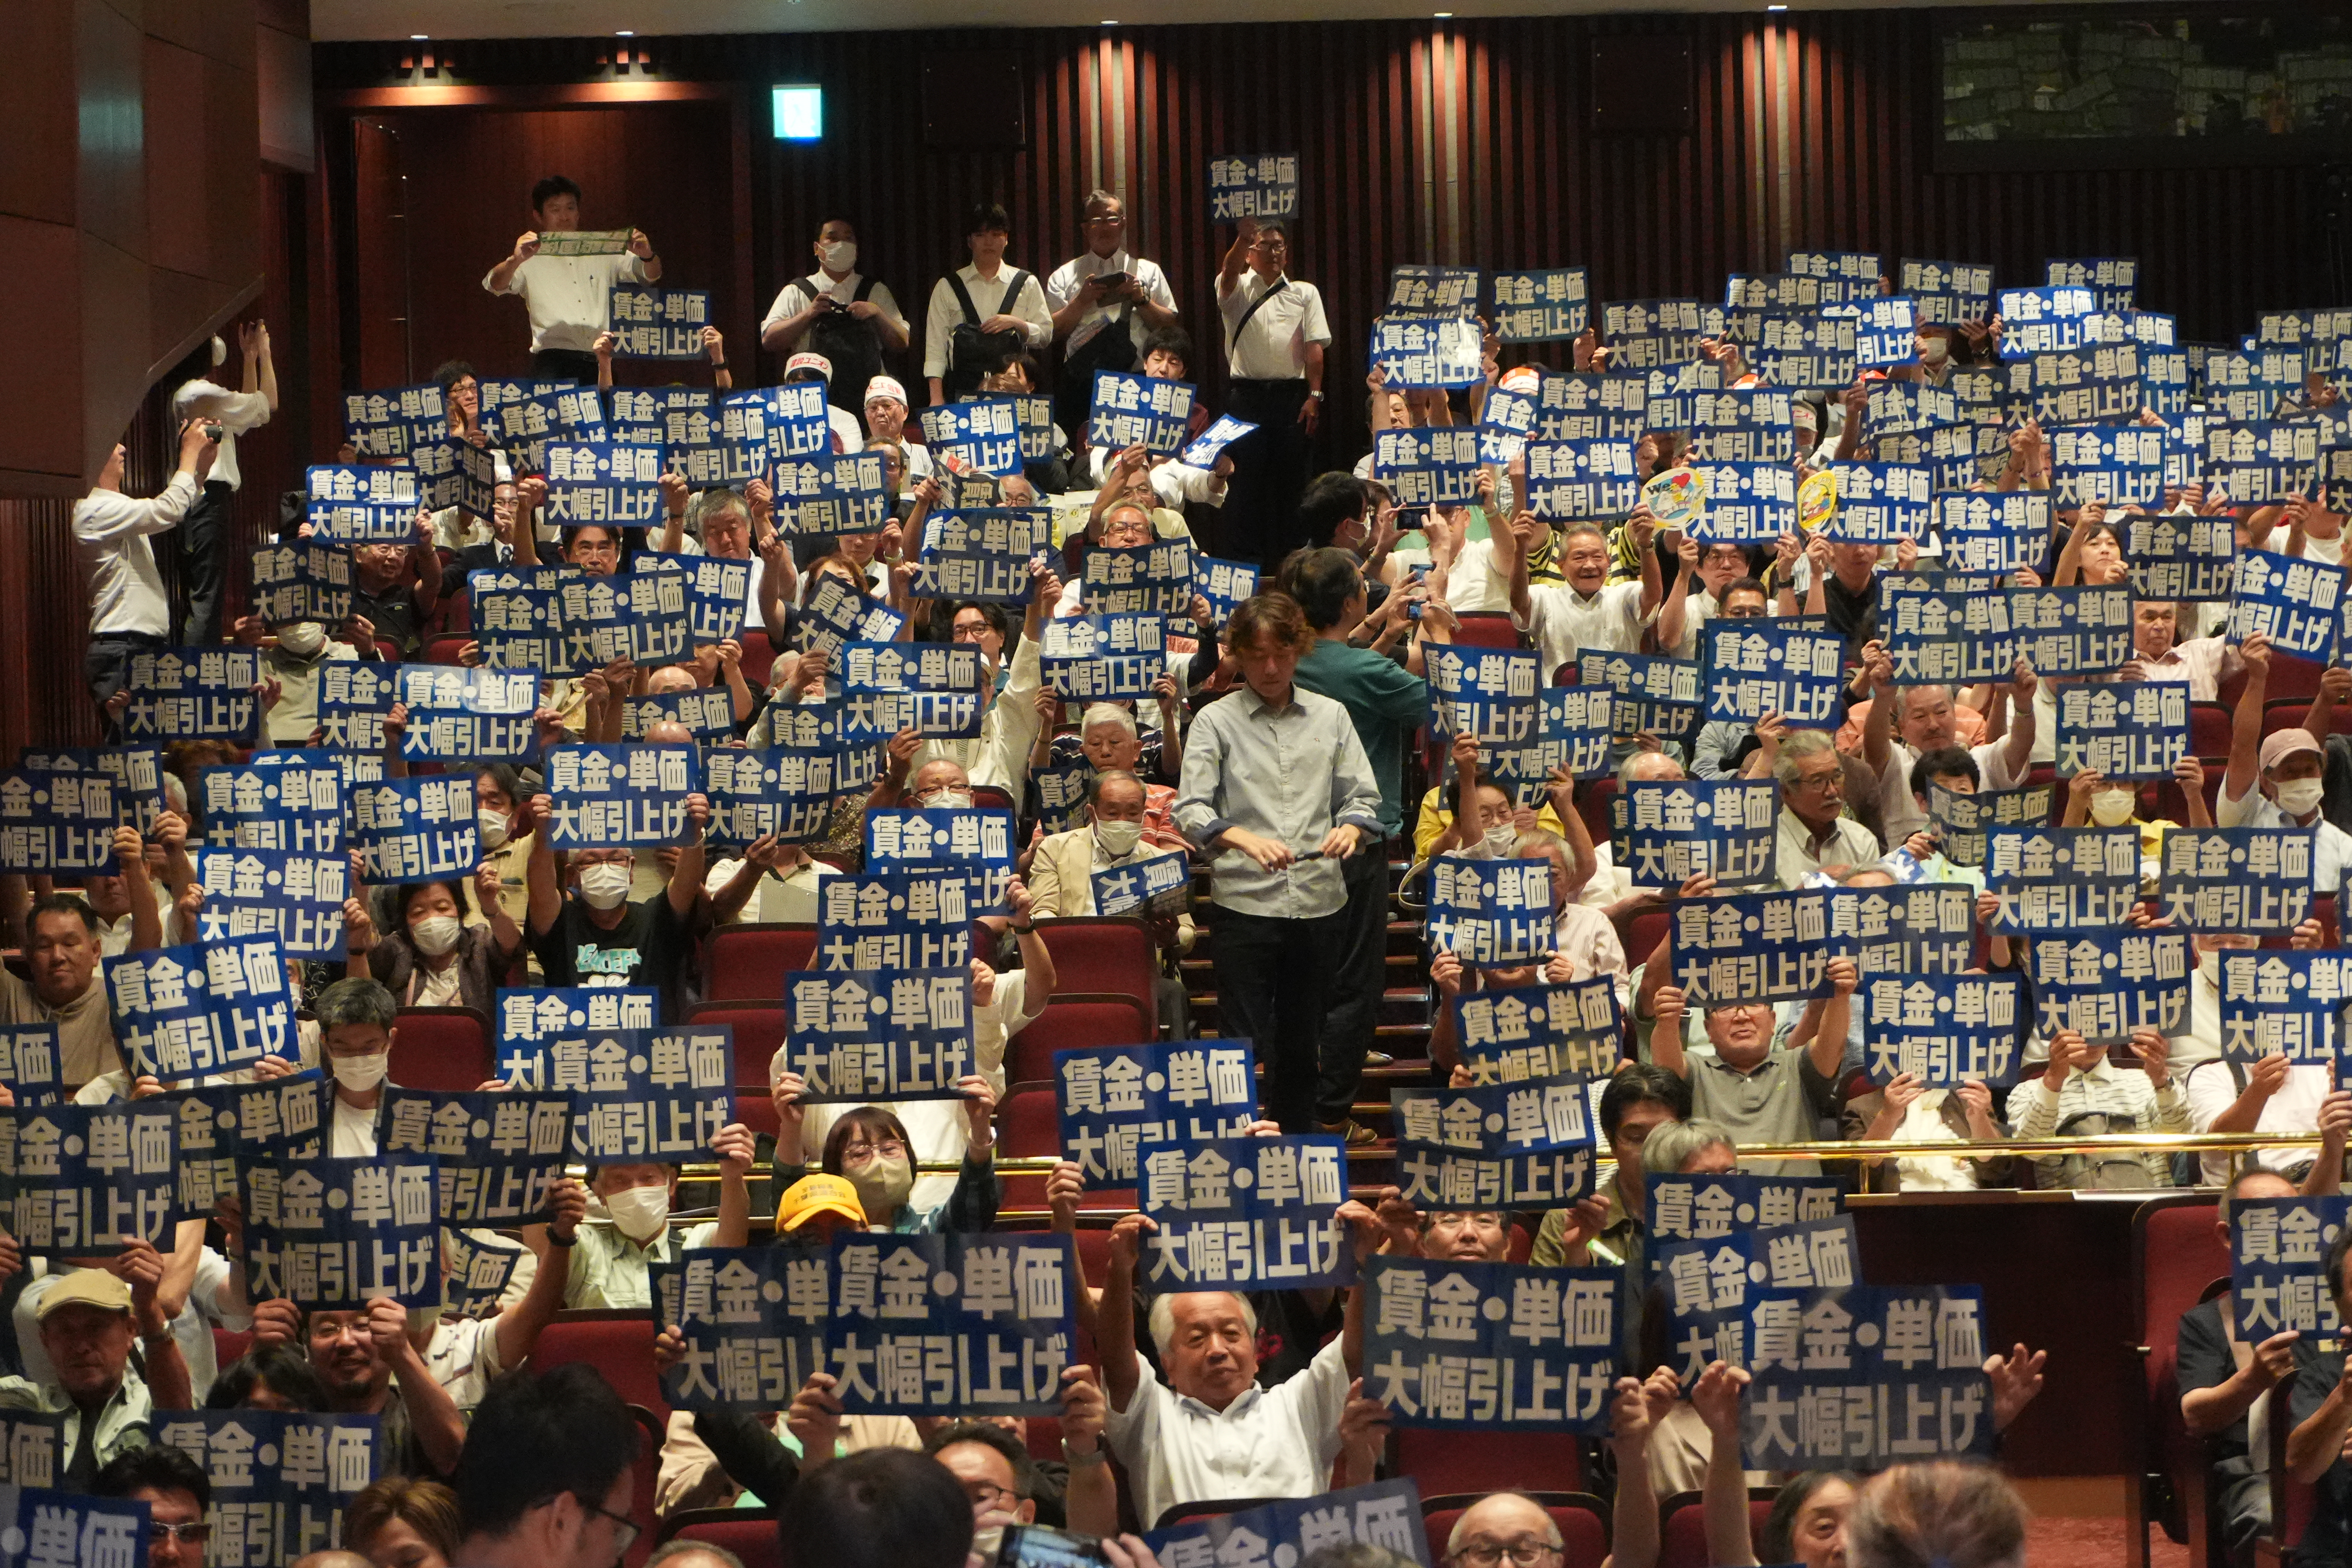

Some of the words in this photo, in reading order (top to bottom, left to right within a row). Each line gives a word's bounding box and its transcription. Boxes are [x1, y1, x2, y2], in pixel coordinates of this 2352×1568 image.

[1211, 157, 1295, 187] 賃金・単価
[1213, 188, 1295, 218] 大幅引上げ
[1790, 254, 1878, 278] 賃金・単価
[1903, 263, 1990, 295] 賃金・単価
[2048, 261, 2134, 287] 賃金・単価
[613, 292, 705, 322] 賃金・単価
[1495, 272, 1585, 305] 賃金・単価
[1728, 278, 1818, 307] 賃金・単価
[2001, 290, 2093, 321] 賃金・単価
[1495, 305, 1586, 338] 大幅引上げ
[1606, 303, 1699, 335] 賃金・単価
[1763, 320, 1854, 351] 賃金・単価
[2083, 314, 2172, 345] 賃金・単価
[2260, 312, 2352, 343] 賃金・単価
[613, 327, 703, 355] 大幅引上げ
[1608, 337, 1701, 367] 大幅引上げ
[1384, 355, 1487, 385] 大幅引上げ
[1761, 355, 1855, 386] 大幅引上げ
[2035, 345, 2137, 386] 賃金・単価
[2207, 354, 2301, 386] 賃金・単価
[346, 387, 443, 423] 賃金・単価
[501, 391, 601, 437] 賃金・単価
[1096, 375, 1192, 418] 賃金・単価
[1542, 377, 1645, 411] 賃金・単価
[1694, 394, 1790, 426] 賃金・単価
[2036, 381, 2139, 422] 大幅引上げ
[351, 420, 446, 454] 大幅引上げ
[666, 408, 764, 444] 賃金・単価
[921, 404, 1013, 443] 賃金・単価
[1092, 412, 1183, 450] 大幅引上げ
[1539, 415, 1644, 441] 大幅引上げ
[669, 444, 766, 481] 大幅引上げ
[1377, 432, 1476, 467] 賃金・単価
[1529, 443, 1633, 479] 賃金・単価
[1692, 430, 1792, 462] 大幅引上げ
[1879, 425, 1972, 463] 賃金・単価
[2054, 432, 2161, 466] 賃金・単価
[2208, 428, 2316, 462] 賃金・単価
[549, 447, 658, 482] 賃金・単価
[776, 457, 881, 496] 賃金・単価
[311, 469, 416, 504] 賃金・単価
[548, 487, 658, 520] 大幅引上げ
[1530, 481, 1636, 517] 大幅引上げ
[2056, 471, 2161, 504] 大幅引上げ
[2208, 468, 2315, 502] 大幅引上げ
[309, 506, 415, 538] 大幅引上げ
[778, 498, 884, 535] 大幅引上げ
[1693, 506, 1795, 539] 大幅引上げ
[1829, 506, 1927, 539] 大幅引上げ
[1944, 496, 2048, 530] 賃金・単価
[922, 516, 1030, 555] 賃金・単価
[1945, 534, 2047, 572] 大幅引上げ
[2128, 521, 2232, 556] 賃金・単価
[252, 547, 349, 585] 賃金・単価
[914, 558, 1031, 595] 大幅引上げ
[1085, 543, 1189, 585] 賃金・単価
[2130, 562, 2232, 596] 大幅引上げ
[253, 584, 351, 620] 大幅引上げ
[562, 576, 684, 621] 賃金・単価
[809, 580, 901, 642] 賃金・単価
[1084, 582, 1191, 614] 大幅引上げ
[1895, 596, 2009, 635] 賃金・単価
[2011, 591, 2128, 629] 賃金・単価
[569, 619, 687, 662] 大幅引上げ
[1044, 617, 1160, 657] 賃金・単価
[2226, 595, 2331, 652] 大幅引上げ
[131, 653, 252, 689] 賃金・単価
[847, 648, 975, 688] 賃金・単価
[1714, 632, 1840, 677] 賃金・単価
[1894, 639, 2013, 679] 大幅引上げ
[2015, 632, 2129, 671] 大幅引上げ
[406, 671, 534, 710] 賃金・単価
[1046, 655, 1162, 696] 大幅引上げ
[1426, 650, 1536, 697] 賃金・単価
[1581, 655, 1697, 702] 賃金・単価
[130, 697, 253, 733] 大幅引上げ
[847, 691, 976, 733] 大幅引上げ
[1711, 677, 1837, 721] 大幅引上げ
[2062, 688, 2185, 729] 賃金・単価
[403, 716, 533, 756] 大幅引上げ
[1494, 734, 1609, 778] 大幅引上げ
[2061, 735, 2186, 774] 大幅引上げ
[551, 750, 687, 792] 賃金・単価
[707, 754, 832, 795] 賃金・単価
[205, 770, 338, 813] 賃金・単価
[354, 780, 472, 829] 賃金・単価
[1633, 787, 1772, 831] 賃金・単価
[209, 817, 340, 852] 大幅引上げ
[551, 800, 688, 841] 大幅引上げ
[707, 801, 828, 839] 大幅引上げ
[872, 816, 1007, 858] 賃金・単価
[361, 827, 475, 877] 大幅引上げ
[1636, 835, 1771, 881] 大幅引上げ
[1992, 834, 2134, 877] 賃金・単価
[2167, 835, 2309, 878] 賃金・単価
[203, 854, 345, 901] 賃金・単価
[1433, 863, 1549, 910] 賃金・単価
[825, 879, 966, 926] 賃金・単価
[1677, 895, 1825, 950] 賃金・単価
[1831, 890, 1968, 938] 賃金・単価
[1991, 884, 2135, 928] 大幅引上げ
[2164, 884, 2309, 928] 大幅引上げ
[201, 904, 346, 951] 大幅引上げ
[1430, 914, 1551, 962] 大幅引上げ
[824, 930, 968, 971] 大幅引上げ
[2036, 935, 2184, 985] 賃金・単価
[111, 942, 282, 1016] 賃金・単価
[1678, 947, 1827, 1000] 大幅引上げ
[503, 994, 652, 1041] 賃金・単価
[793, 977, 964, 1033] 賃金・単価
[1461, 983, 1612, 1047] 賃金・単価
[1870, 980, 2015, 1028] 賃金・単価
[2039, 986, 2187, 1038] 大幅引上げ
[124, 1001, 288, 1075] 大幅引上げ
[1870, 1034, 2014, 1082] 大幅引上げ
[551, 1035, 725, 1092] 賃金・単価
[794, 1037, 967, 1094] 大幅引上げ
[1469, 1034, 1617, 1088] 大幅引上げ
[1062, 1049, 1248, 1115] 賃金・単価
[387, 1098, 568, 1156] 賃金・単価
[1400, 1084, 1586, 1149] 賃金・単価
[249, 1165, 431, 1228] 賃金・単価
[1145, 1145, 1341, 1212] 賃金・単価
[1402, 1149, 1589, 1204] 大幅引上げ
[1653, 1182, 1837, 1239] 賃金・単価
[251, 1236, 433, 1301] 大幅引上げ
[1149, 1218, 1343, 1282] 大幅引上げ
[837, 1246, 1064, 1320] 賃金・単価
[1669, 1228, 1853, 1316] 賃金・単価
[1376, 1268, 1614, 1347] 賃金・単価
[1750, 1297, 1981, 1371] 賃金・単価
[831, 1332, 1067, 1404] 大幅引上げ
[1374, 1350, 1612, 1421] 大幅引上げ
[1750, 1383, 1984, 1457] 大幅引上げ
